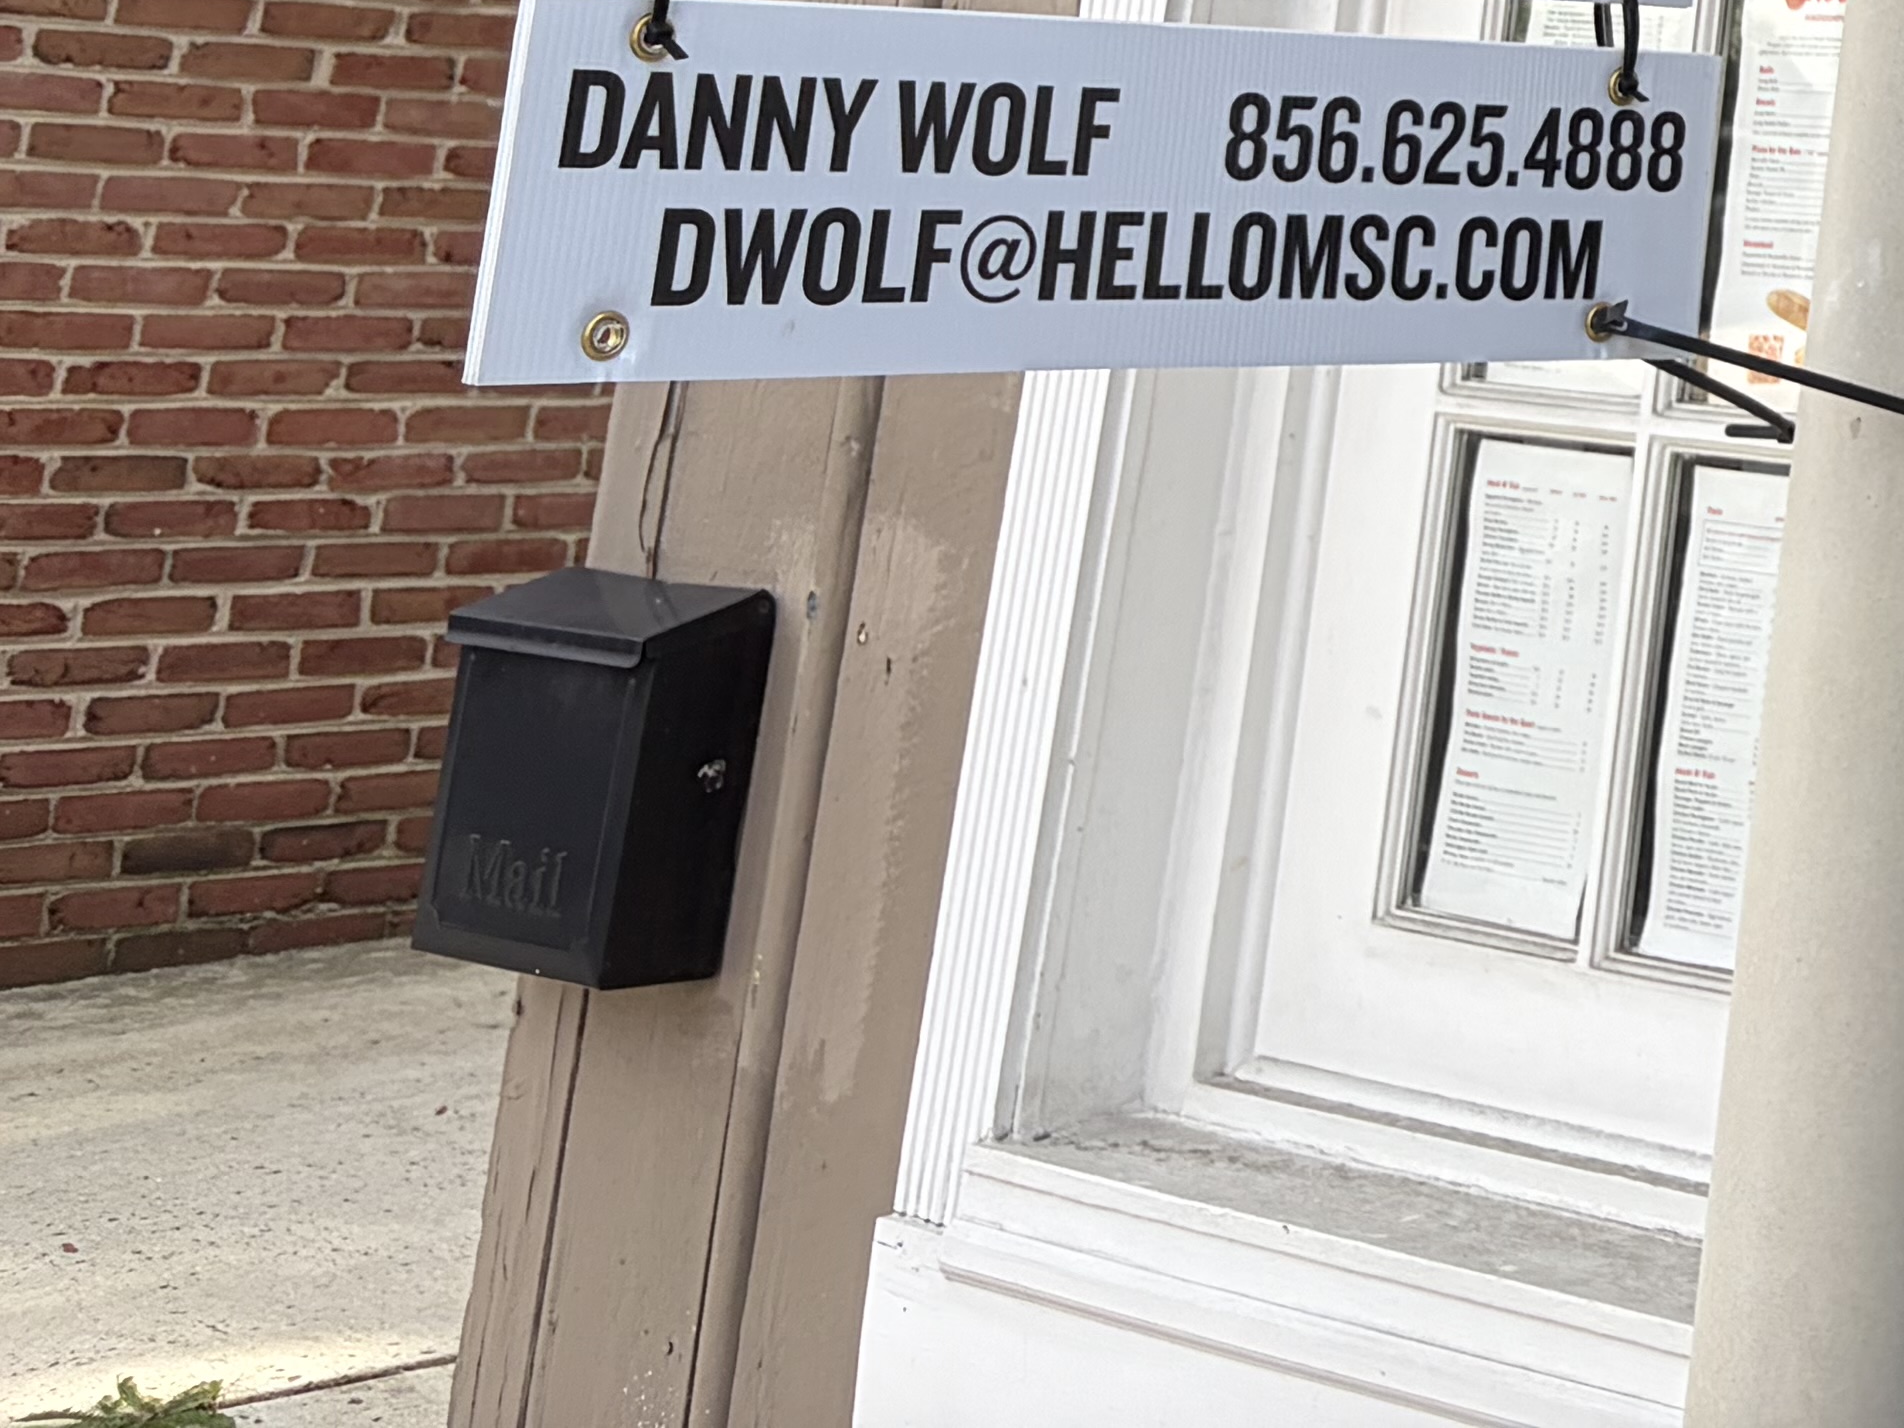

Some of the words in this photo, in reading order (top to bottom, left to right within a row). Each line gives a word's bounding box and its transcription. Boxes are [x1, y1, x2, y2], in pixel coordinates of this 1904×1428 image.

[558, 69, 878, 172] DANNY
[899, 81, 1120, 176] WOLF
[1225, 93, 1685, 192] 856.625.4888
[651, 208, 1603, 306] DWOLF@HELLOMSC.COM
[459, 833, 568, 918] Mail
